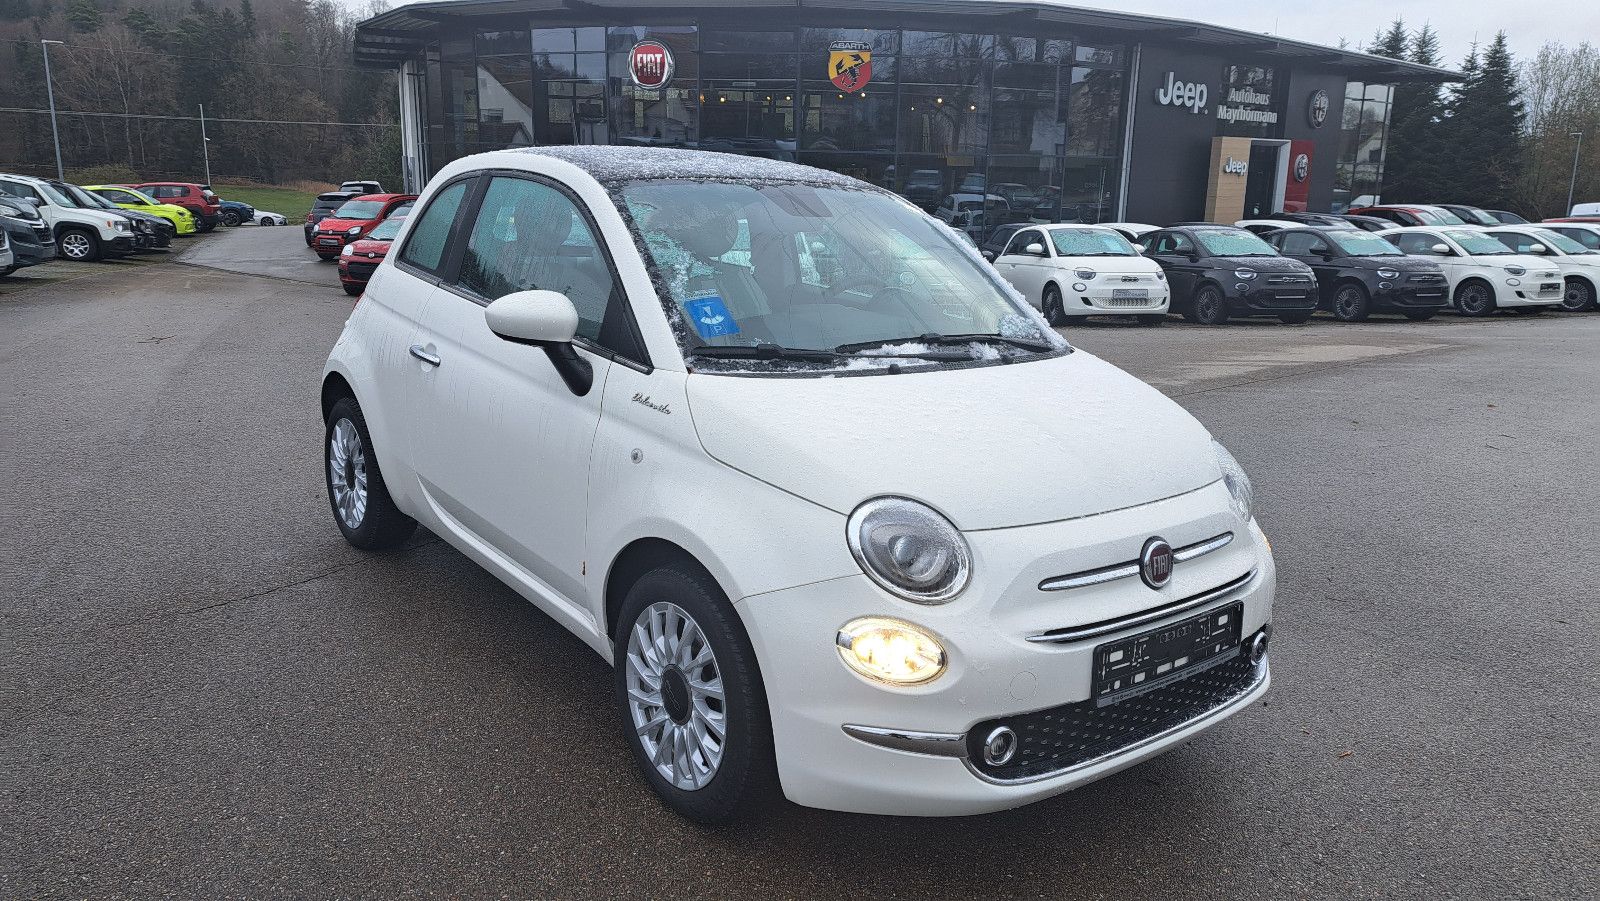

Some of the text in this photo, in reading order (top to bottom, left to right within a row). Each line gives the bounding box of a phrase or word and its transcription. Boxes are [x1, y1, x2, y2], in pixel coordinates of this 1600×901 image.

[831, 42, 869, 50] ABARTH
[637, 53, 662, 76] FIAT
[1158, 71, 1207, 114] Jeep
[1228, 87, 1270, 105] Autohaus
[1225, 157, 1247, 175] Jeep
[713, 325, 722, 334] P
[1153, 553, 1169, 576] FIAT
